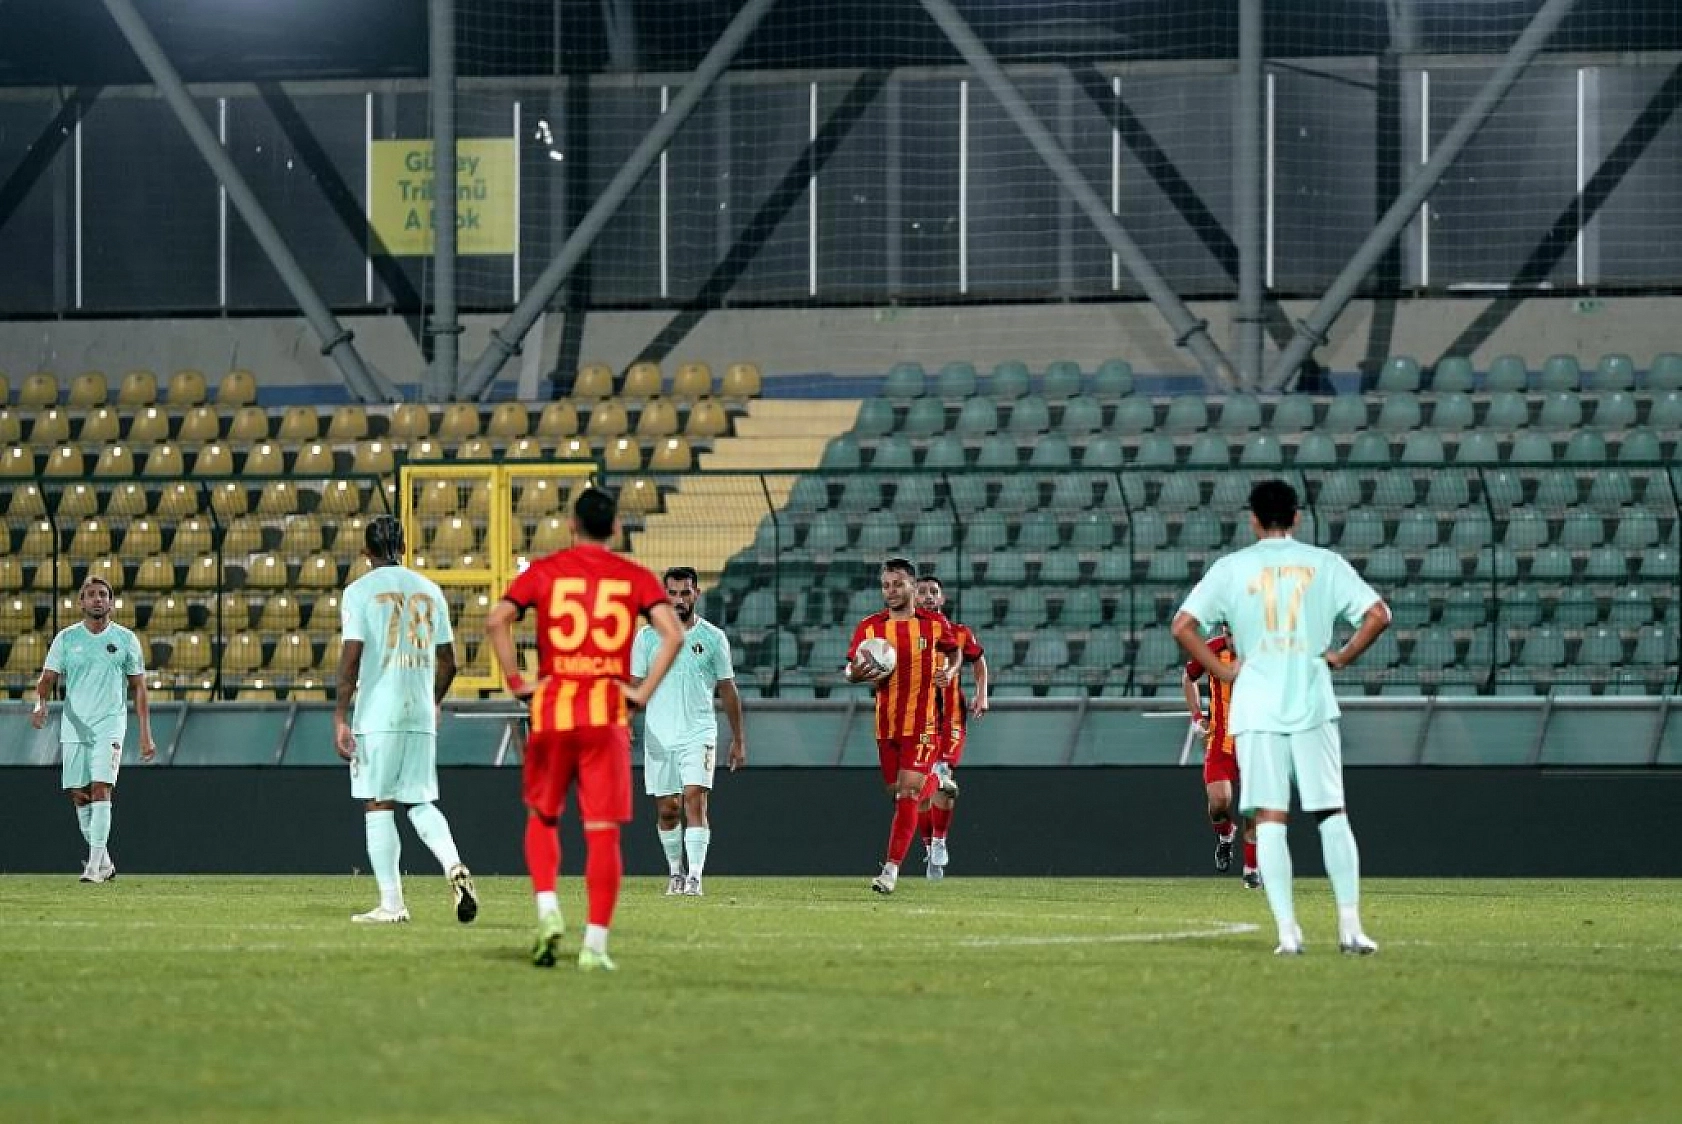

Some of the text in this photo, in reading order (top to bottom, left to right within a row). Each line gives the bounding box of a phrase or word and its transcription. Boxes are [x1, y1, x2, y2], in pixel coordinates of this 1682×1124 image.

[404, 150, 480, 176] Güey
[404, 207, 421, 230] A
[374, 591, 434, 649] 78
[548, 577, 632, 651] 55
[1247, 566, 1316, 632] 17
[916, 743, 936, 763] 17
